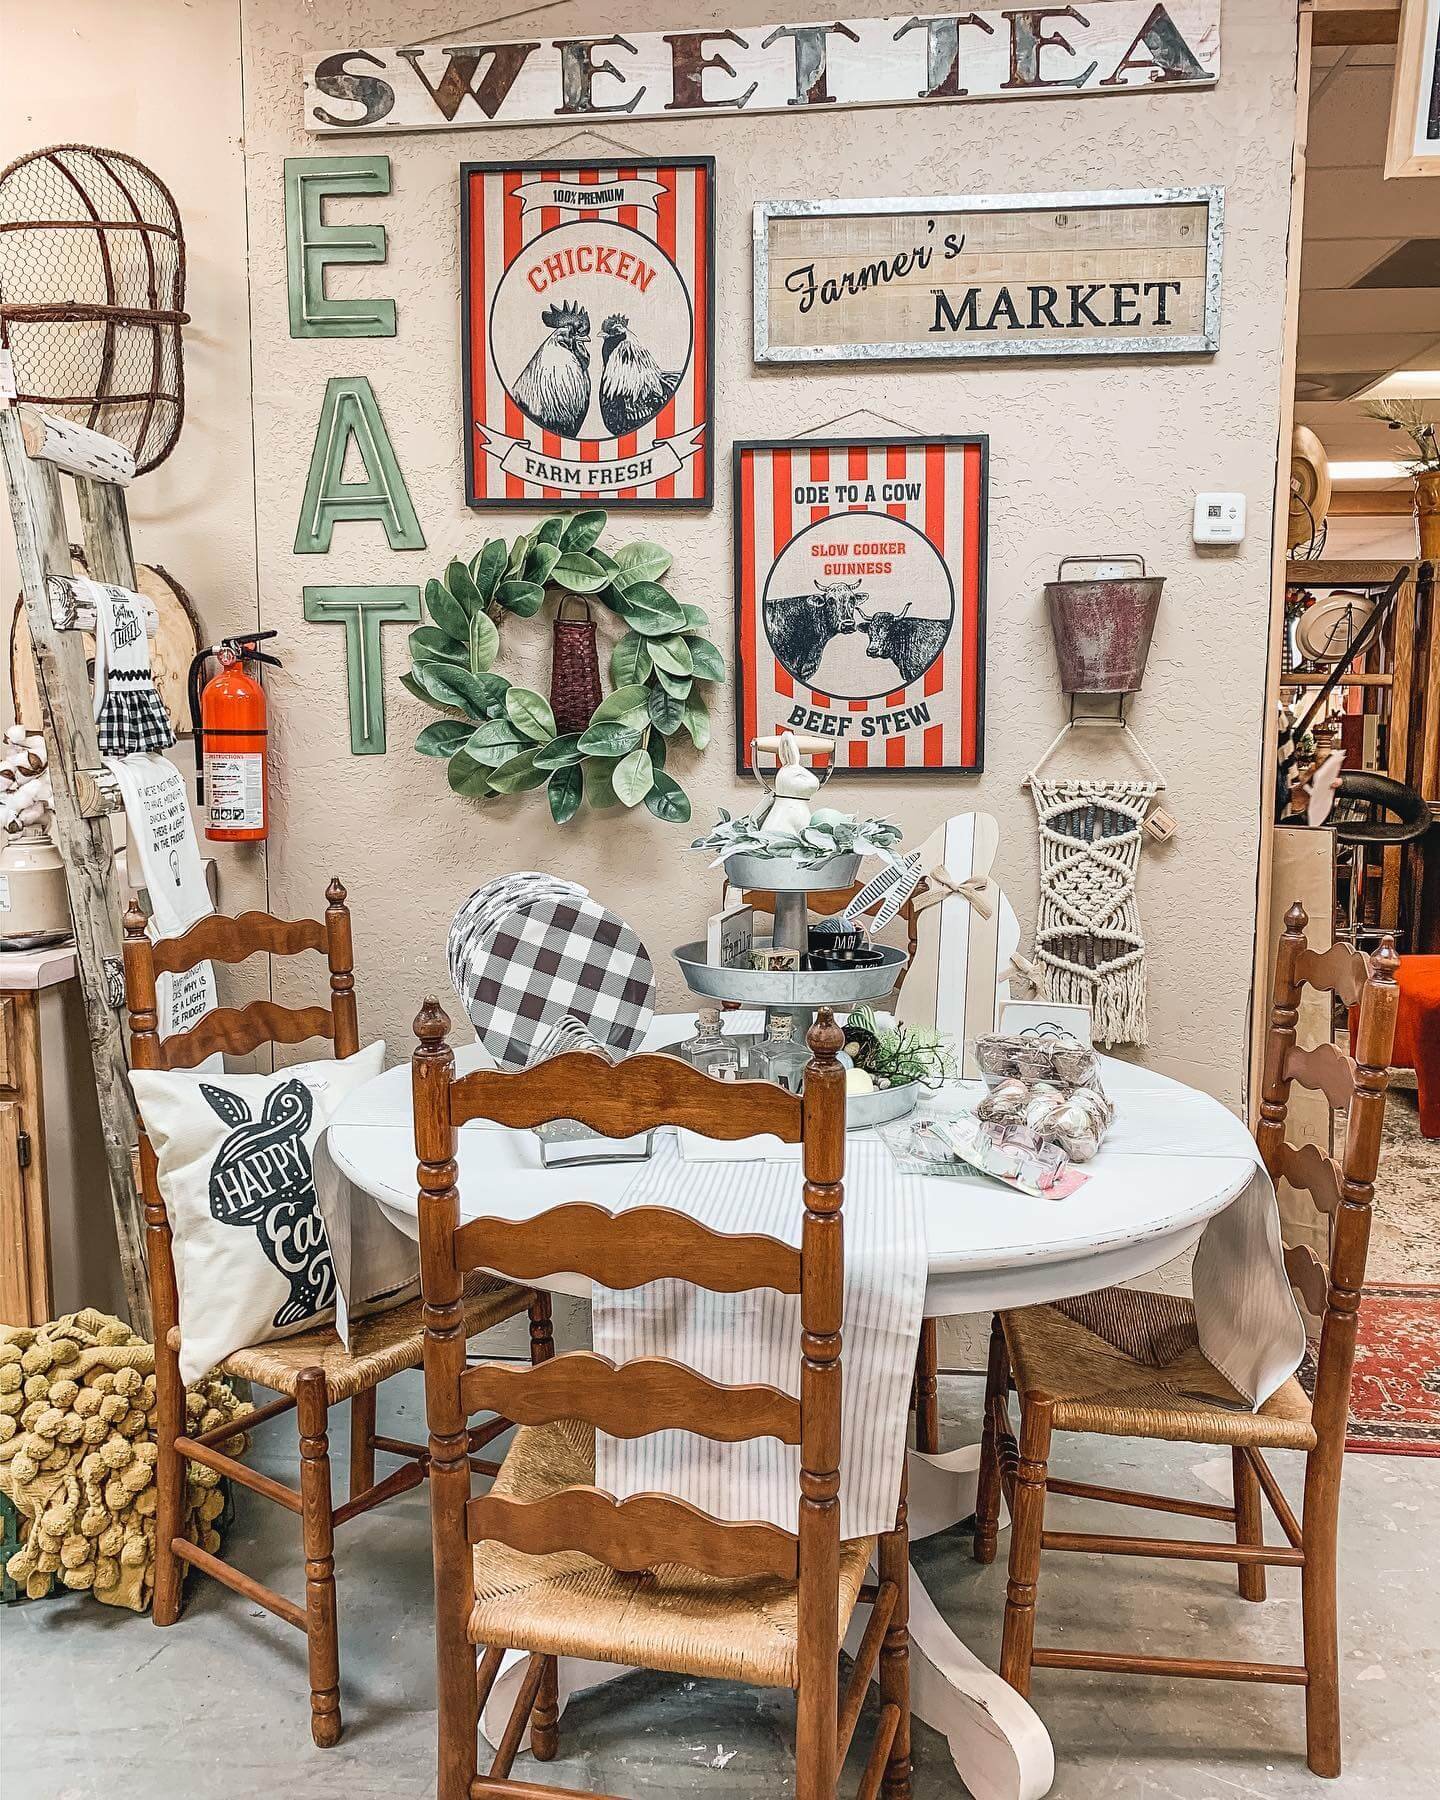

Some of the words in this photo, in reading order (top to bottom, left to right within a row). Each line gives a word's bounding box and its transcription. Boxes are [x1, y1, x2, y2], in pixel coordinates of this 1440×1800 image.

[313, 22, 860, 127] SWEET
[893, 3, 1215, 98] TEA
[553, 189, 576, 204] 100%
[578, 189, 624, 205] PREMIUM
[527, 246, 657, 293] CHICKEN
[785, 220, 965, 313] Farmer's
[928, 281, 1181, 332] MARKET
[525, 456, 581, 485] FARM
[588, 458, 652, 485] FRESH
[794, 486, 829, 504] ODE
[835, 485, 858, 503] TO
[864, 484, 876, 502] A
[882, 483, 921, 501] COW
[811, 543, 849, 557] SLOW
[853, 542, 906, 556] COOKER
[824, 562, 892, 575] GUINNESS
[787, 704, 852, 737] BEEF
[861, 702, 931, 737] STEW
[214, 1133, 310, 1215] HAPPY
